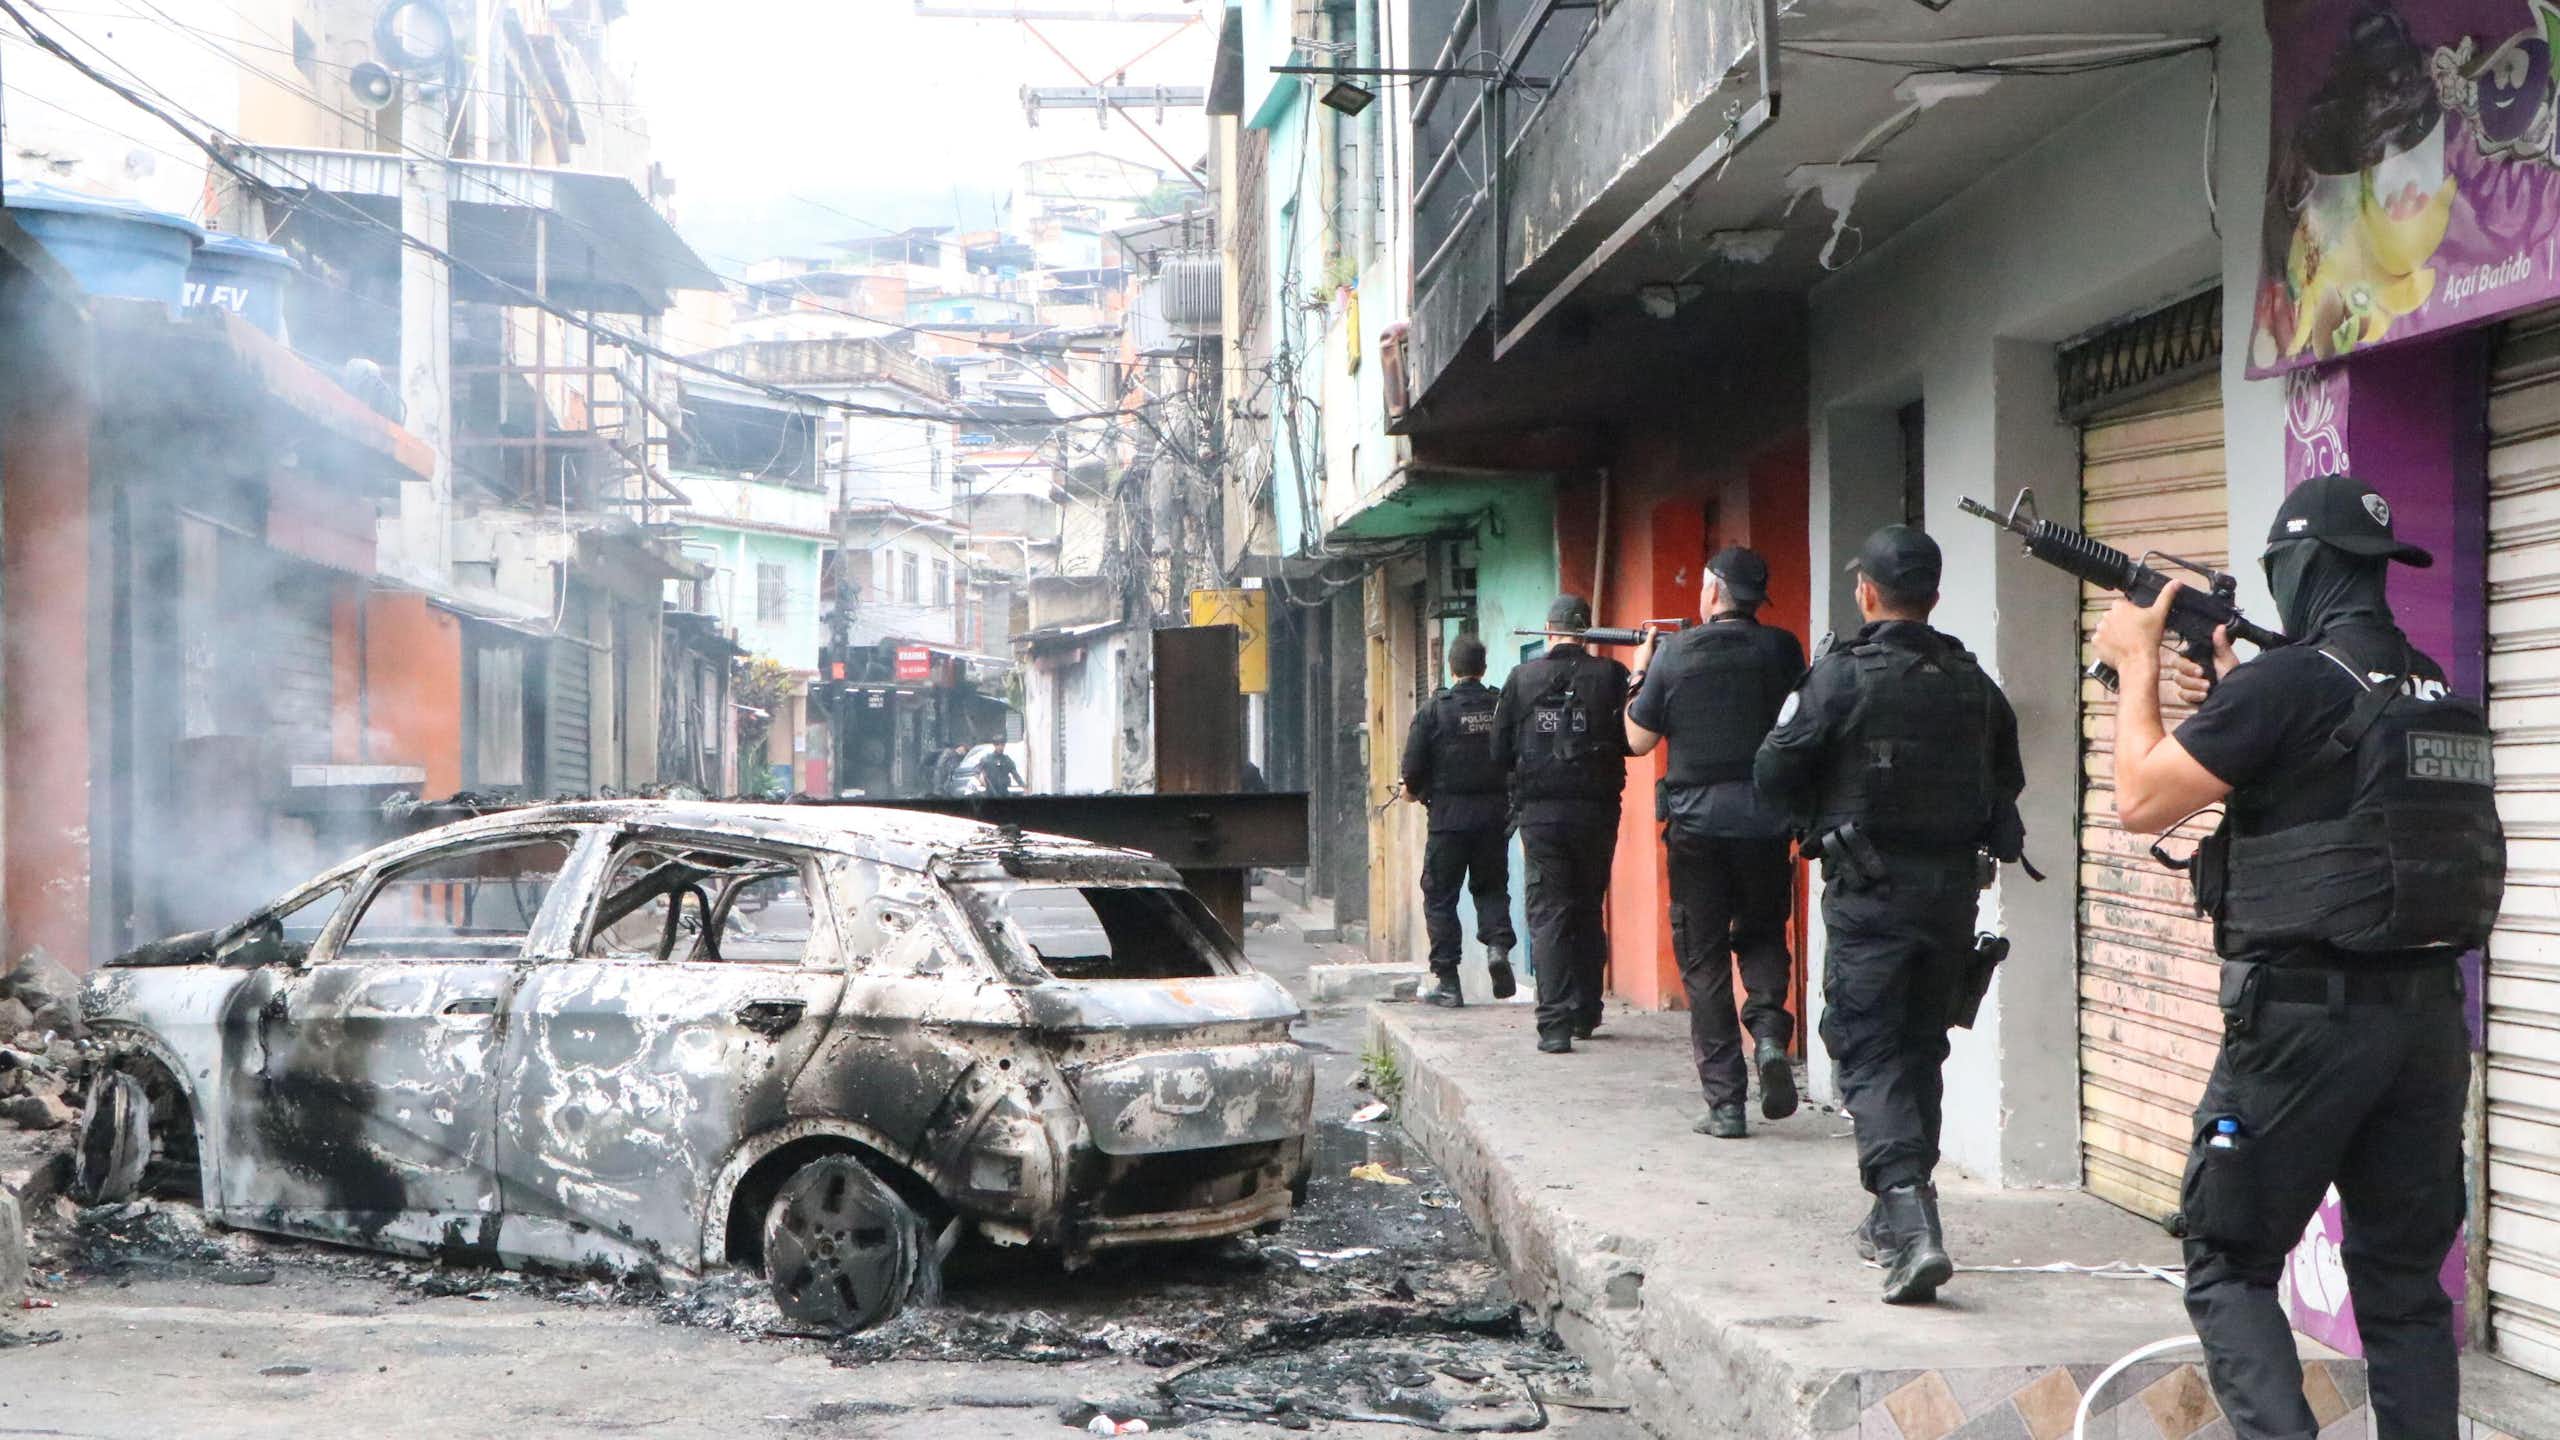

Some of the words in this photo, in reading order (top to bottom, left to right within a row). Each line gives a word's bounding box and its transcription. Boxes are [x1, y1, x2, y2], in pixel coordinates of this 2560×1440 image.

[2442, 266, 2479, 309] Açaí
[2478, 250, 2531, 294] Batido
[1538, 711, 1584, 721] POLIA
[1542, 721, 1580, 731] CIL
